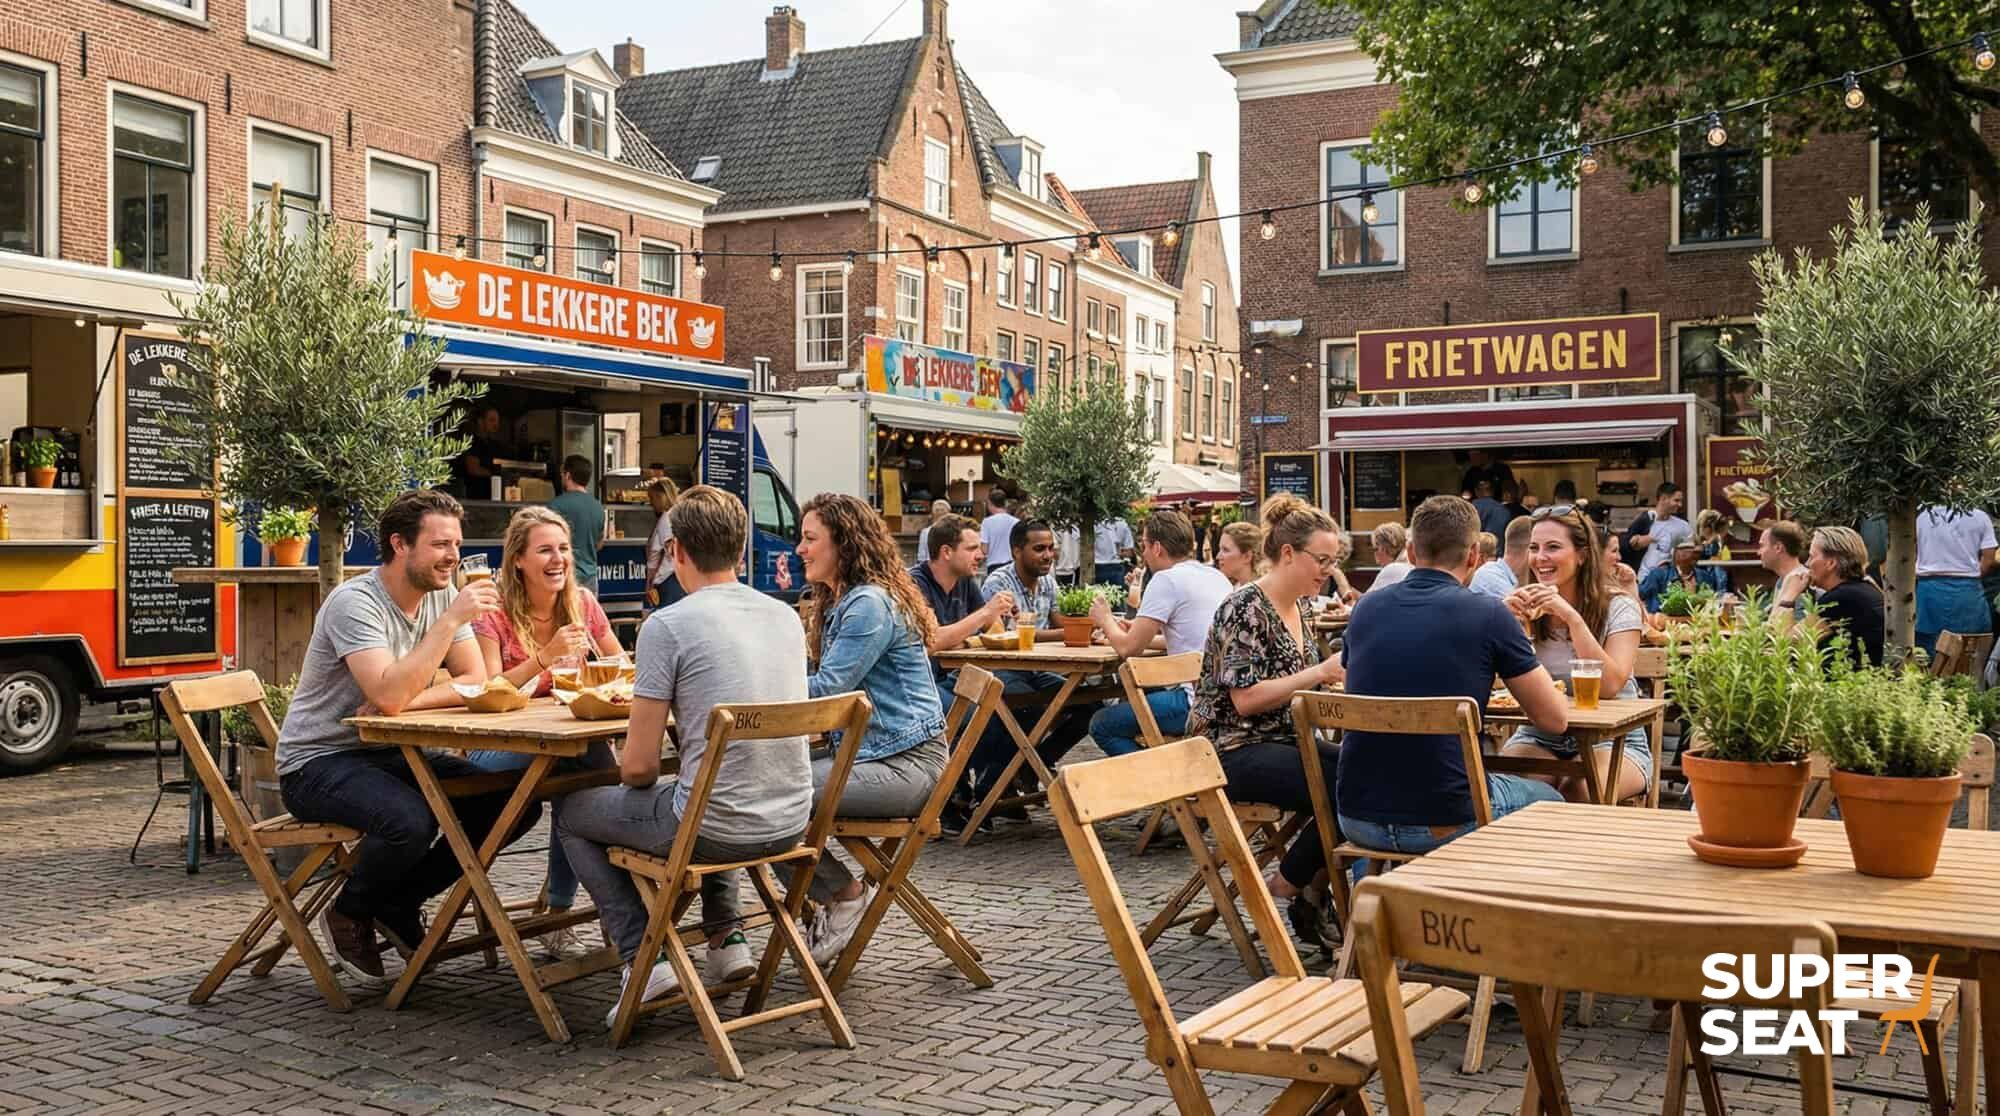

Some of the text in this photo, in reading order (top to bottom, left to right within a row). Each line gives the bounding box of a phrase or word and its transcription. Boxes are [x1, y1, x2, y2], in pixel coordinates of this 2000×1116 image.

[477, 272, 678, 345] DE LEKKERE BEK
[128, 344, 188, 366] DE LEKKERE
[924, 357, 975, 392] LEKKERE
[1385, 328, 1627, 381] FRIETWAGEN
